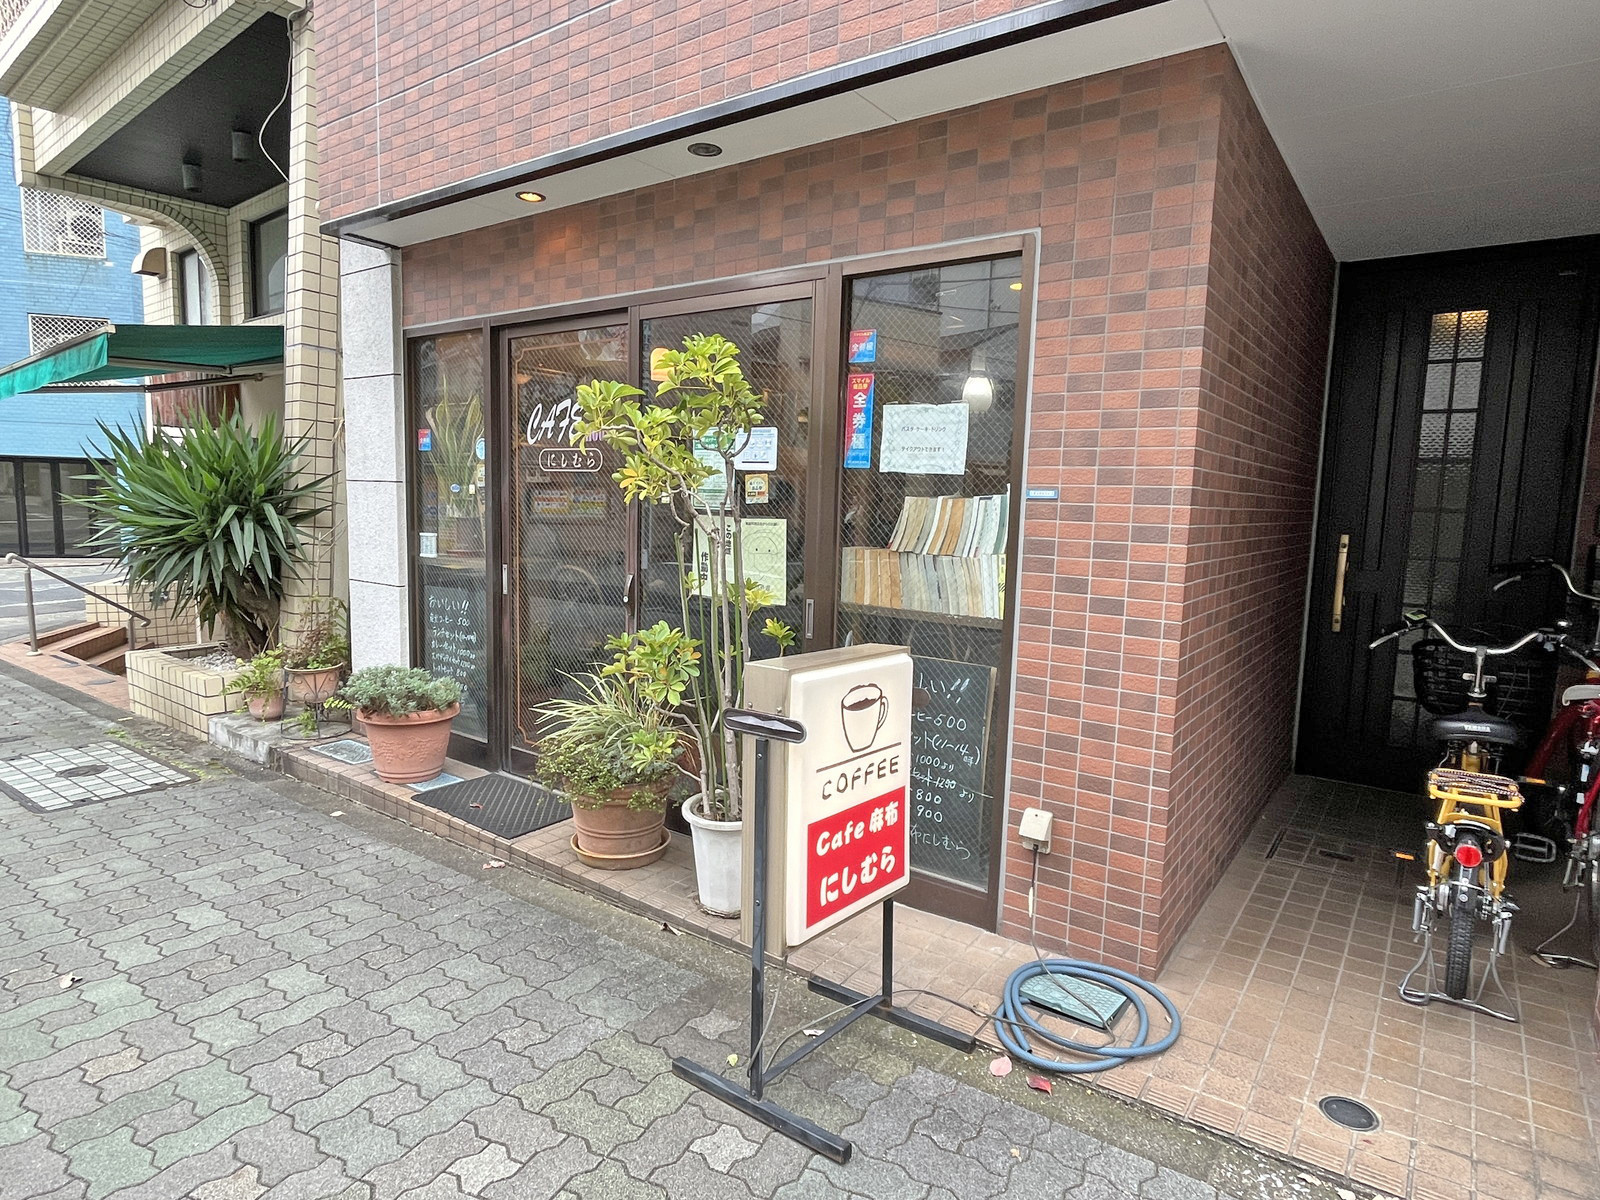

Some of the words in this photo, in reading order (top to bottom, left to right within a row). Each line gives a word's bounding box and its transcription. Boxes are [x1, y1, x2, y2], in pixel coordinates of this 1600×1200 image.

[547, 451, 596, 469] にしむら
[457, 616, 470, 627] 500
[821, 754, 900, 801] COFFEE
[915, 788, 942, 805] 800
[916, 804, 943, 823] 900
[815, 820, 865, 857] Cafe
[868, 801, 899, 834] 麻布
[819, 845, 896, 907] にしむら
